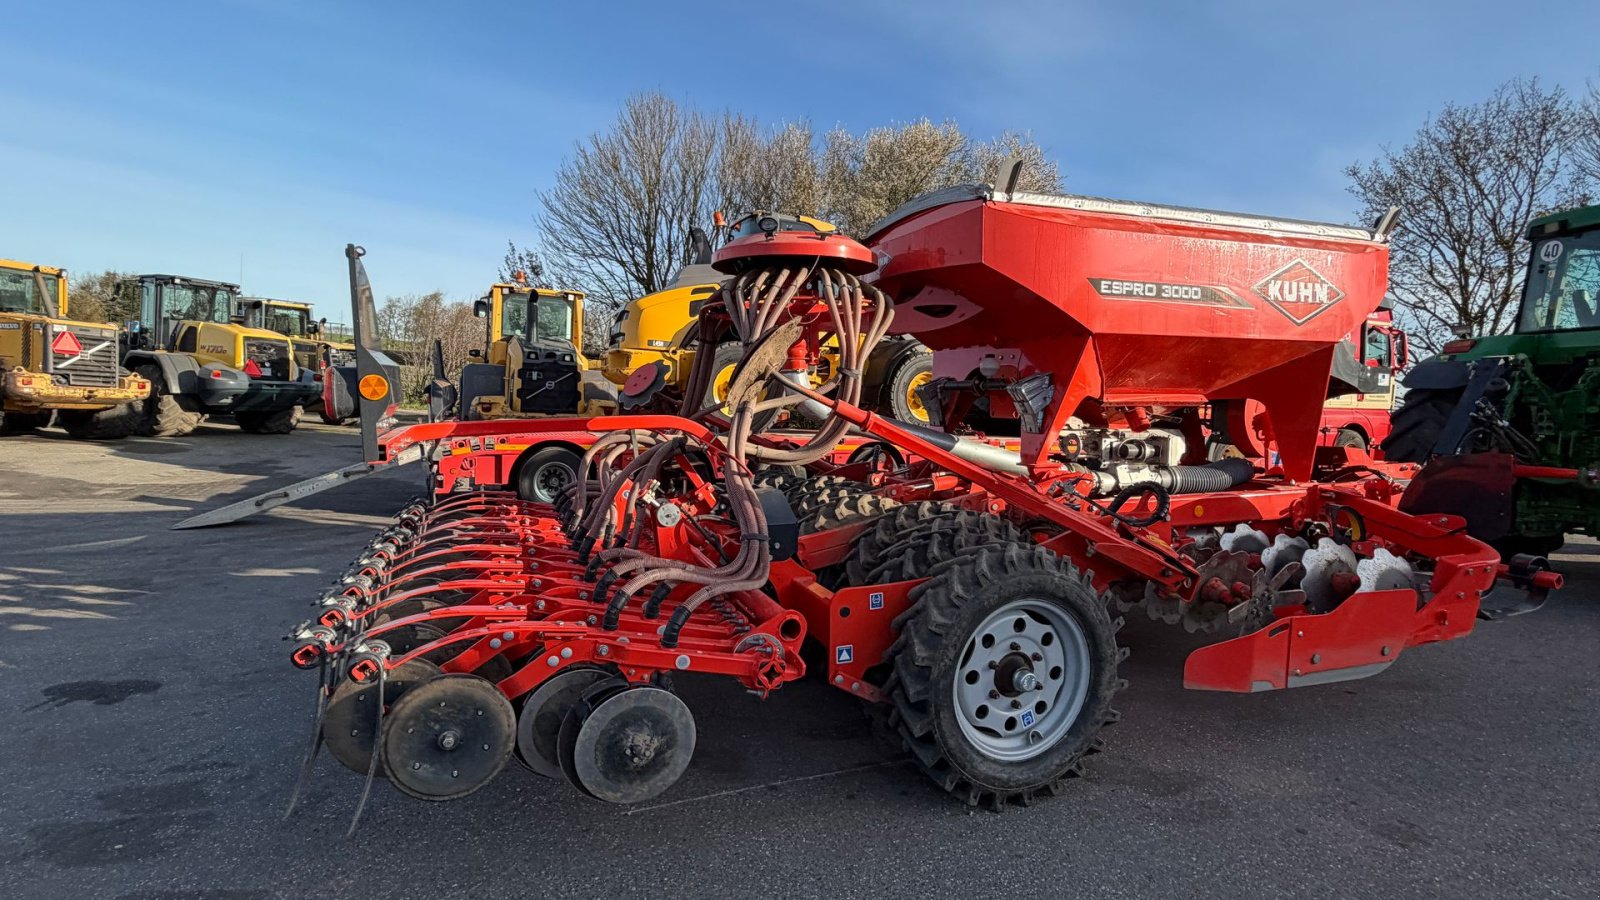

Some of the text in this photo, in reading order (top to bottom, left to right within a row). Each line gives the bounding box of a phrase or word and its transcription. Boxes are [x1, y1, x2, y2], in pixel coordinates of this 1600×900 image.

[1543, 243, 1560, 259] 40
[1100, 280, 1202, 300] ESPRO 3000
[1268, 279, 1329, 304] KUHN
